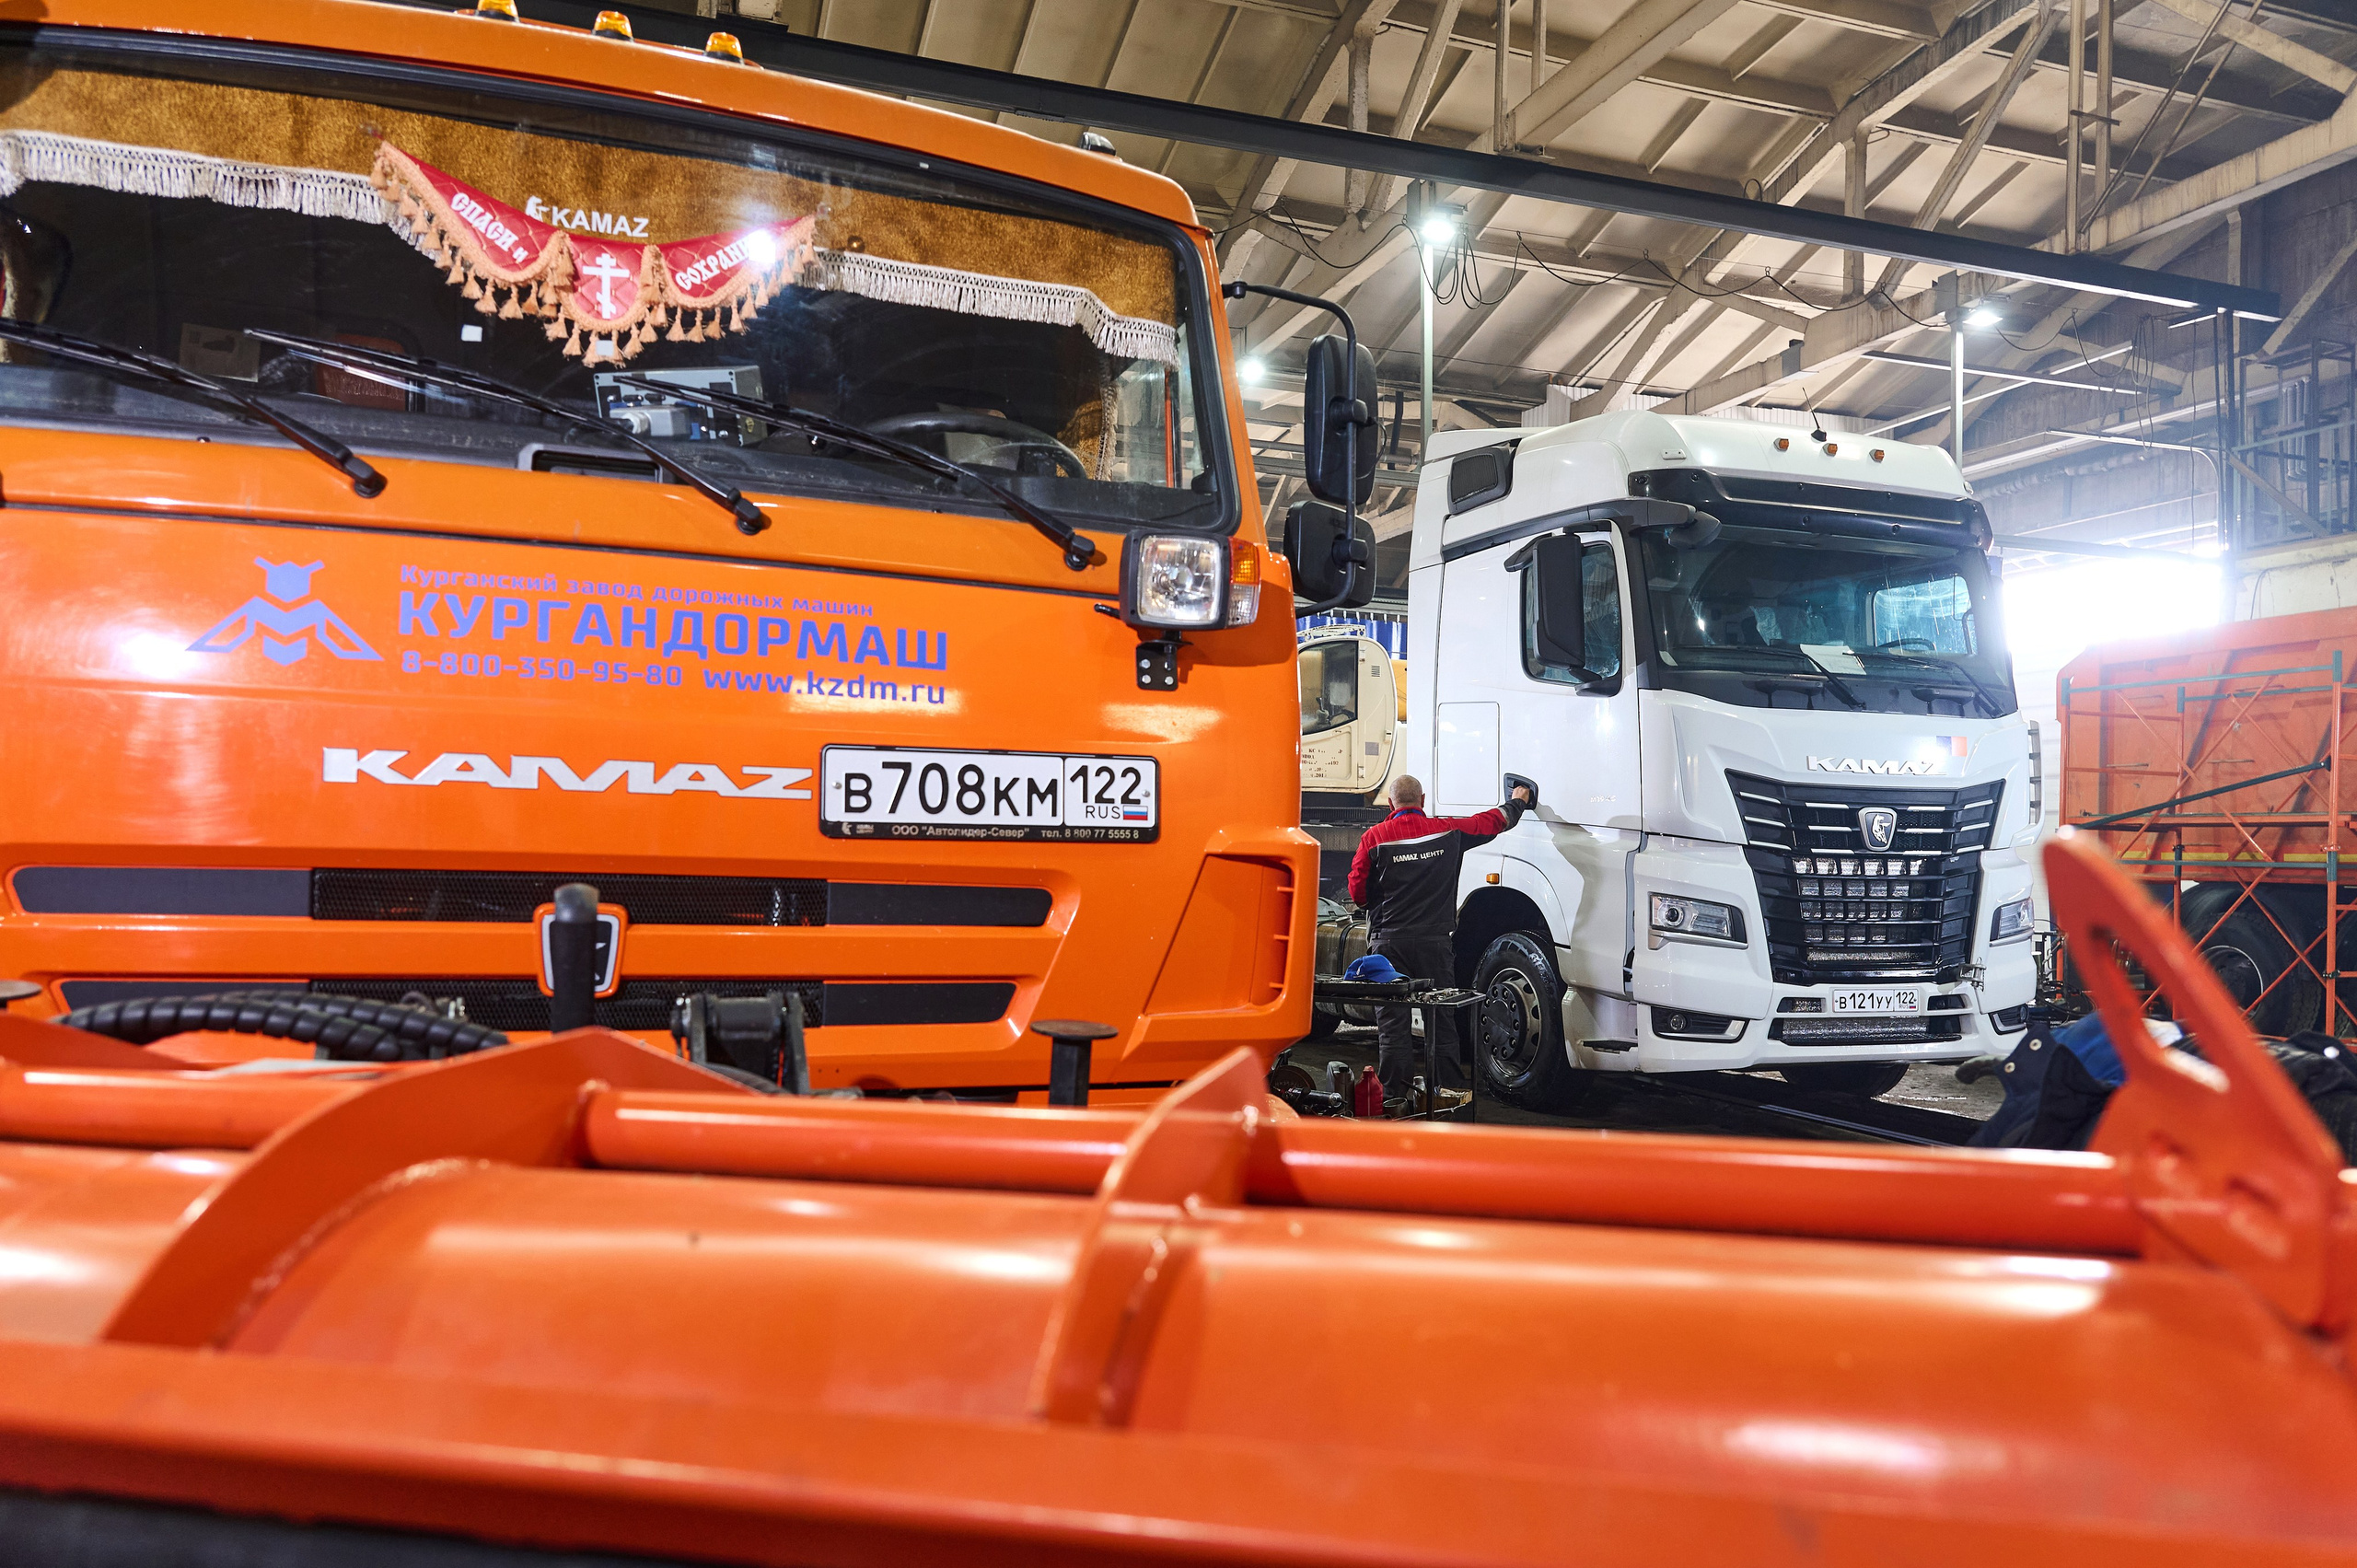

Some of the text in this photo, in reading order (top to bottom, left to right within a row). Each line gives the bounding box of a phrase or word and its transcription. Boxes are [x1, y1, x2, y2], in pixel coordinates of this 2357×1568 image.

[450, 192, 518, 251] СПАСИ
[552, 205, 649, 238] KAMAZ
[401, 564, 873, 617] Курганский завод дорожных машин
[399, 590, 946, 671] КУРГАНДОРМАШ
[401, 650, 945, 704] 8-800-350-95-80 www.kzdm.ru
[323, 747, 813, 800] KAMAZ
[1806, 755, 1948, 776] KAMAZ
[1070, 764, 1141, 806] 122
[1086, 806, 1120, 819] RUS
[891, 825, 1140, 839] ООО "Автолидер-Север" тел. 8 800 77 5555 8
[1392, 849, 1445, 863] KAMAZ ЦЕНТР
[1896, 992, 1915, 1005] 122
